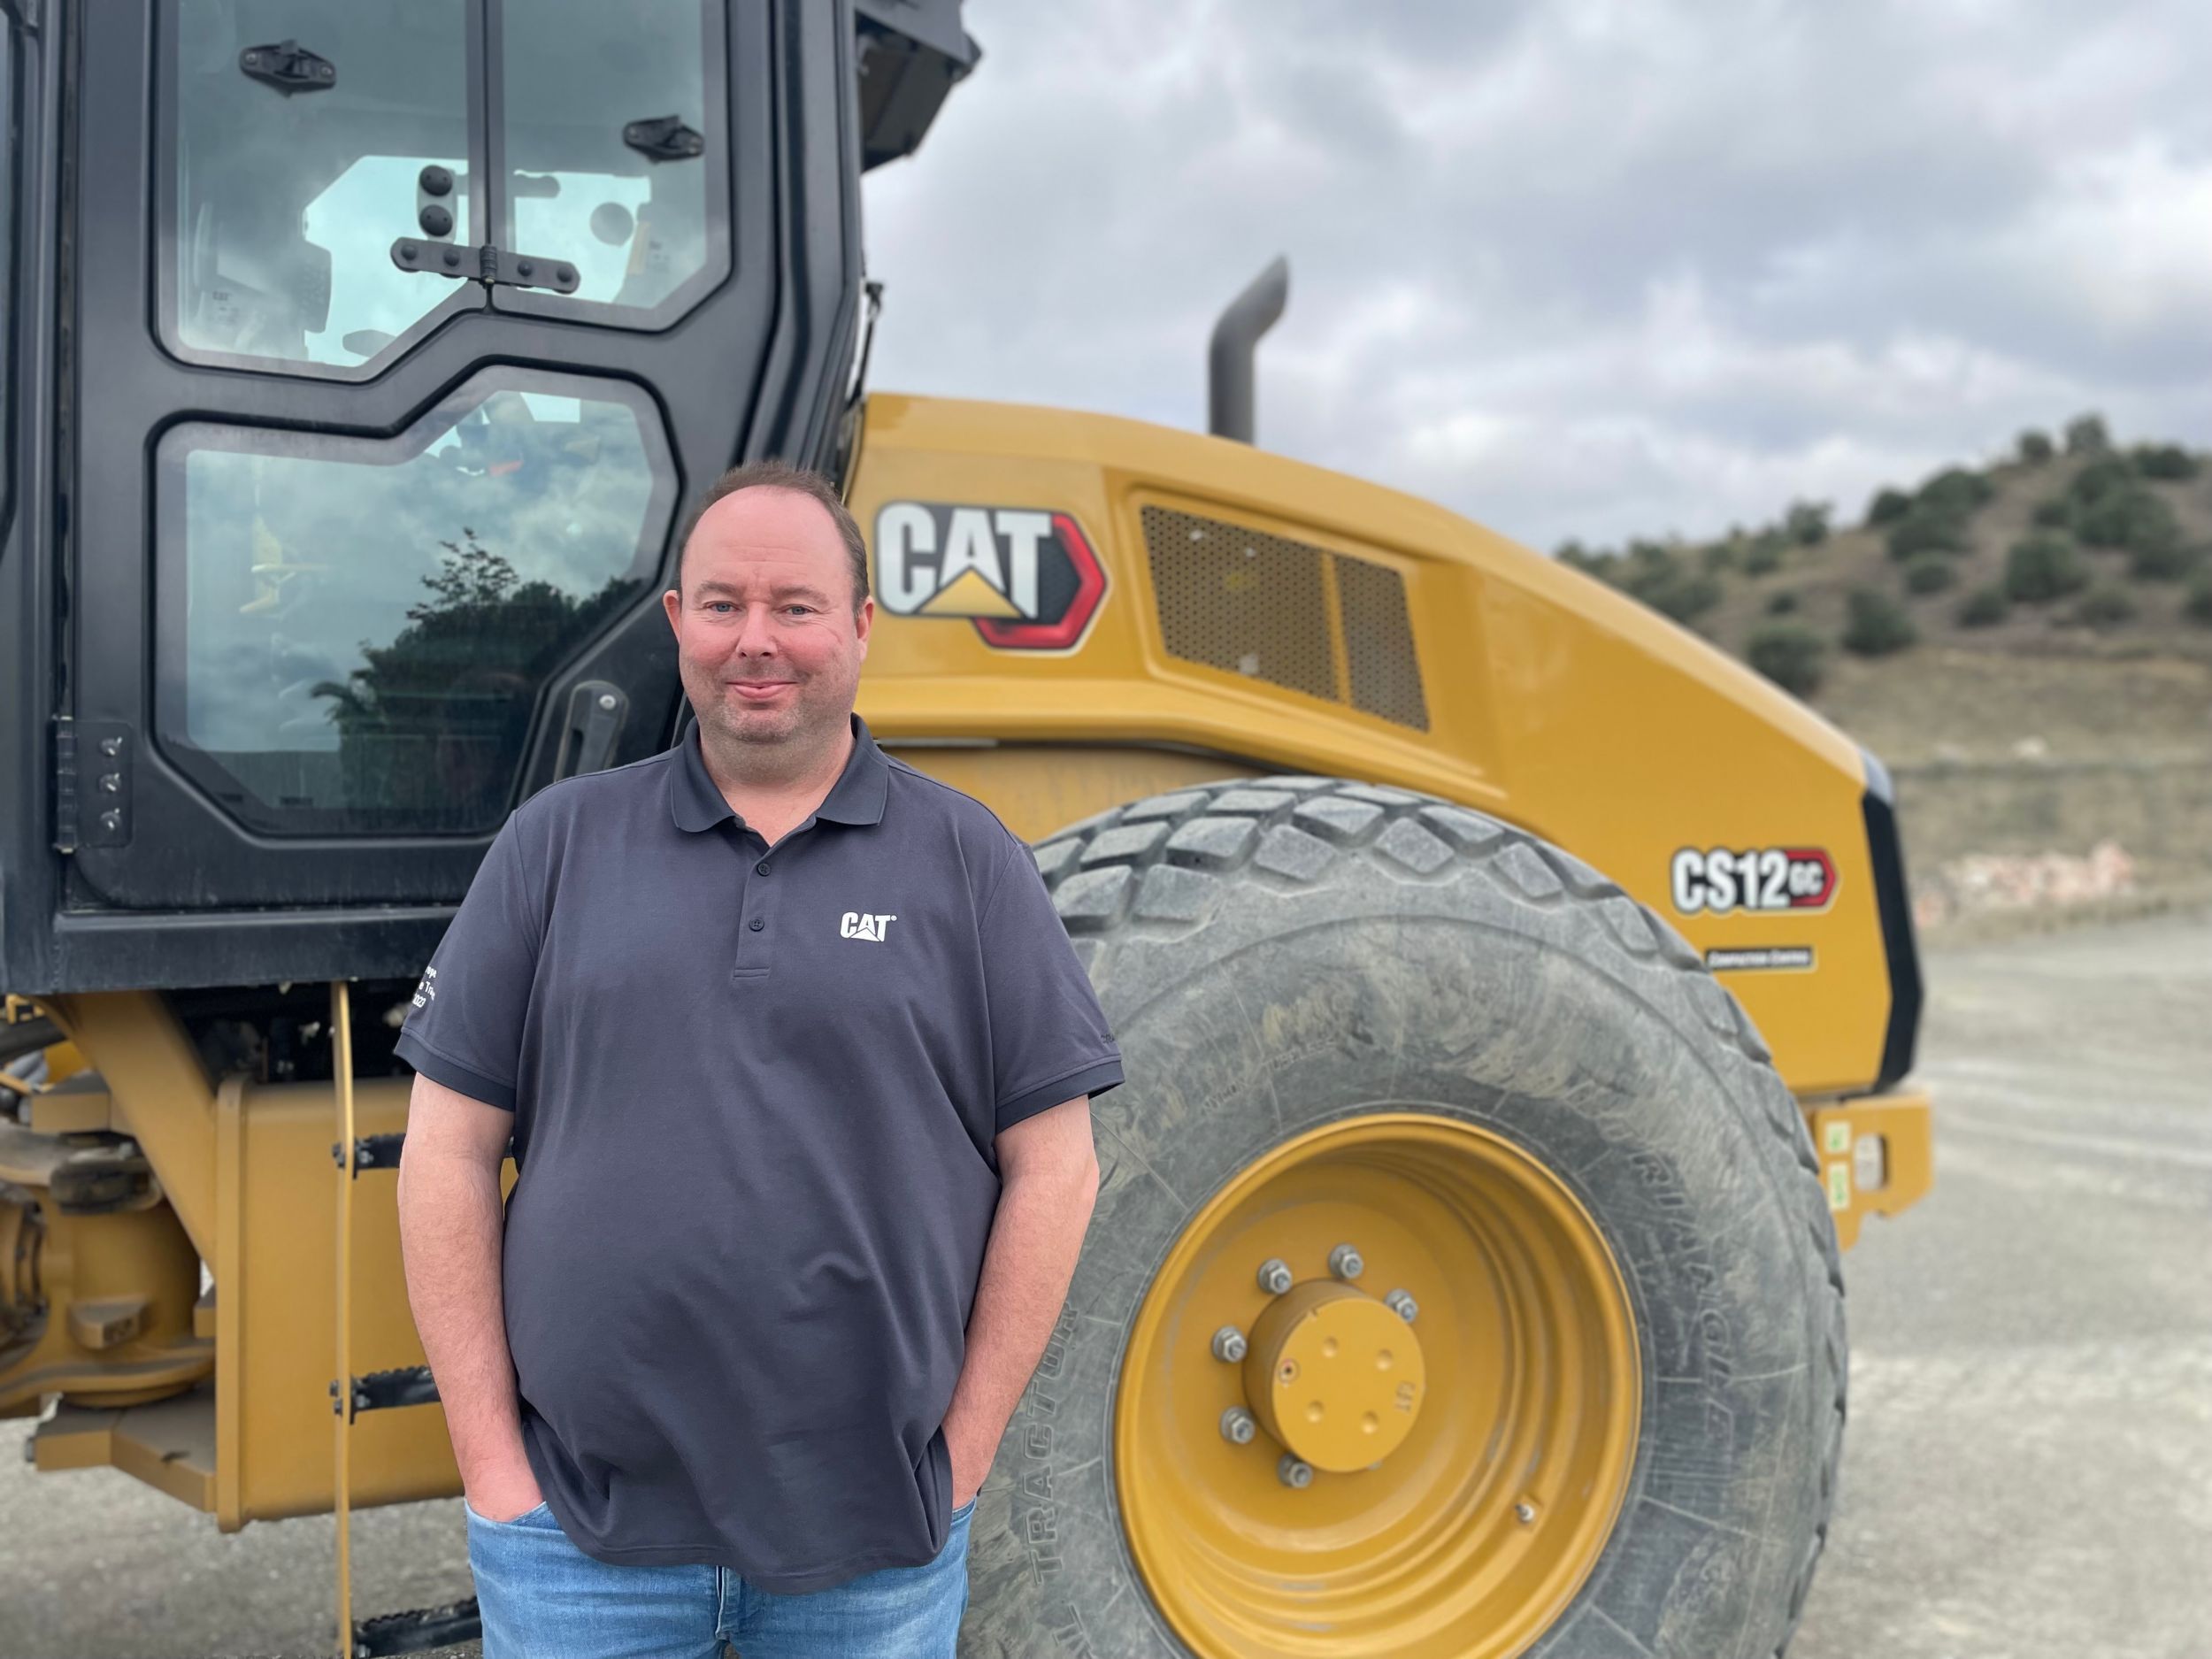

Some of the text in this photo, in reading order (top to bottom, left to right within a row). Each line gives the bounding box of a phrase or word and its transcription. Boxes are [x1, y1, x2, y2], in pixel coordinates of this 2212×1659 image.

[877, 502, 1053, 618] CAT
[1672, 849, 1789, 911] CS12
[840, 911, 891, 942] CAT
